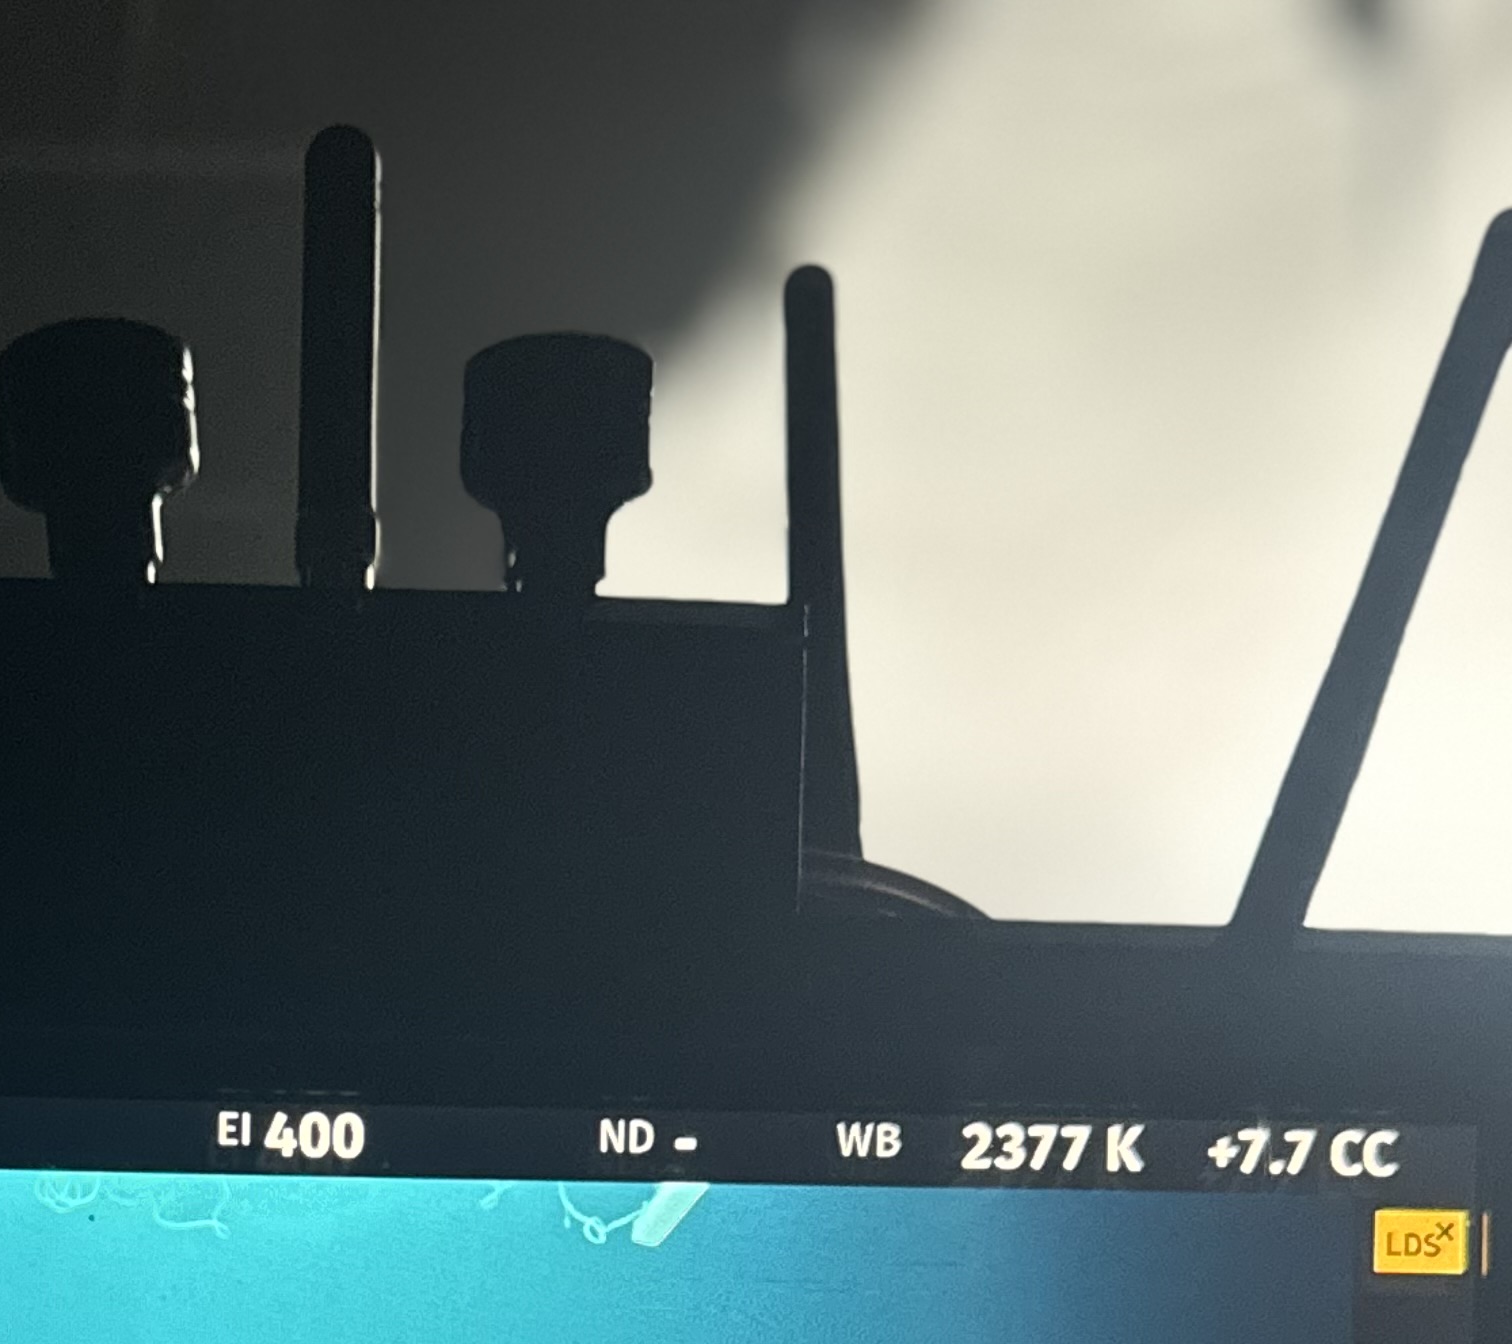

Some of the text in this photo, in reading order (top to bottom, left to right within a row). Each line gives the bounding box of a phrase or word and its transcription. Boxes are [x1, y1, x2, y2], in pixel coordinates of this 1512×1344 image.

[217, 1110, 366, 1160] EI 400
[599, 1118, 656, 1155] ND
[836, 1121, 1400, 1178] WB 2377 K +7.7 CC
[1386, 1231, 1442, 1258] LDS
